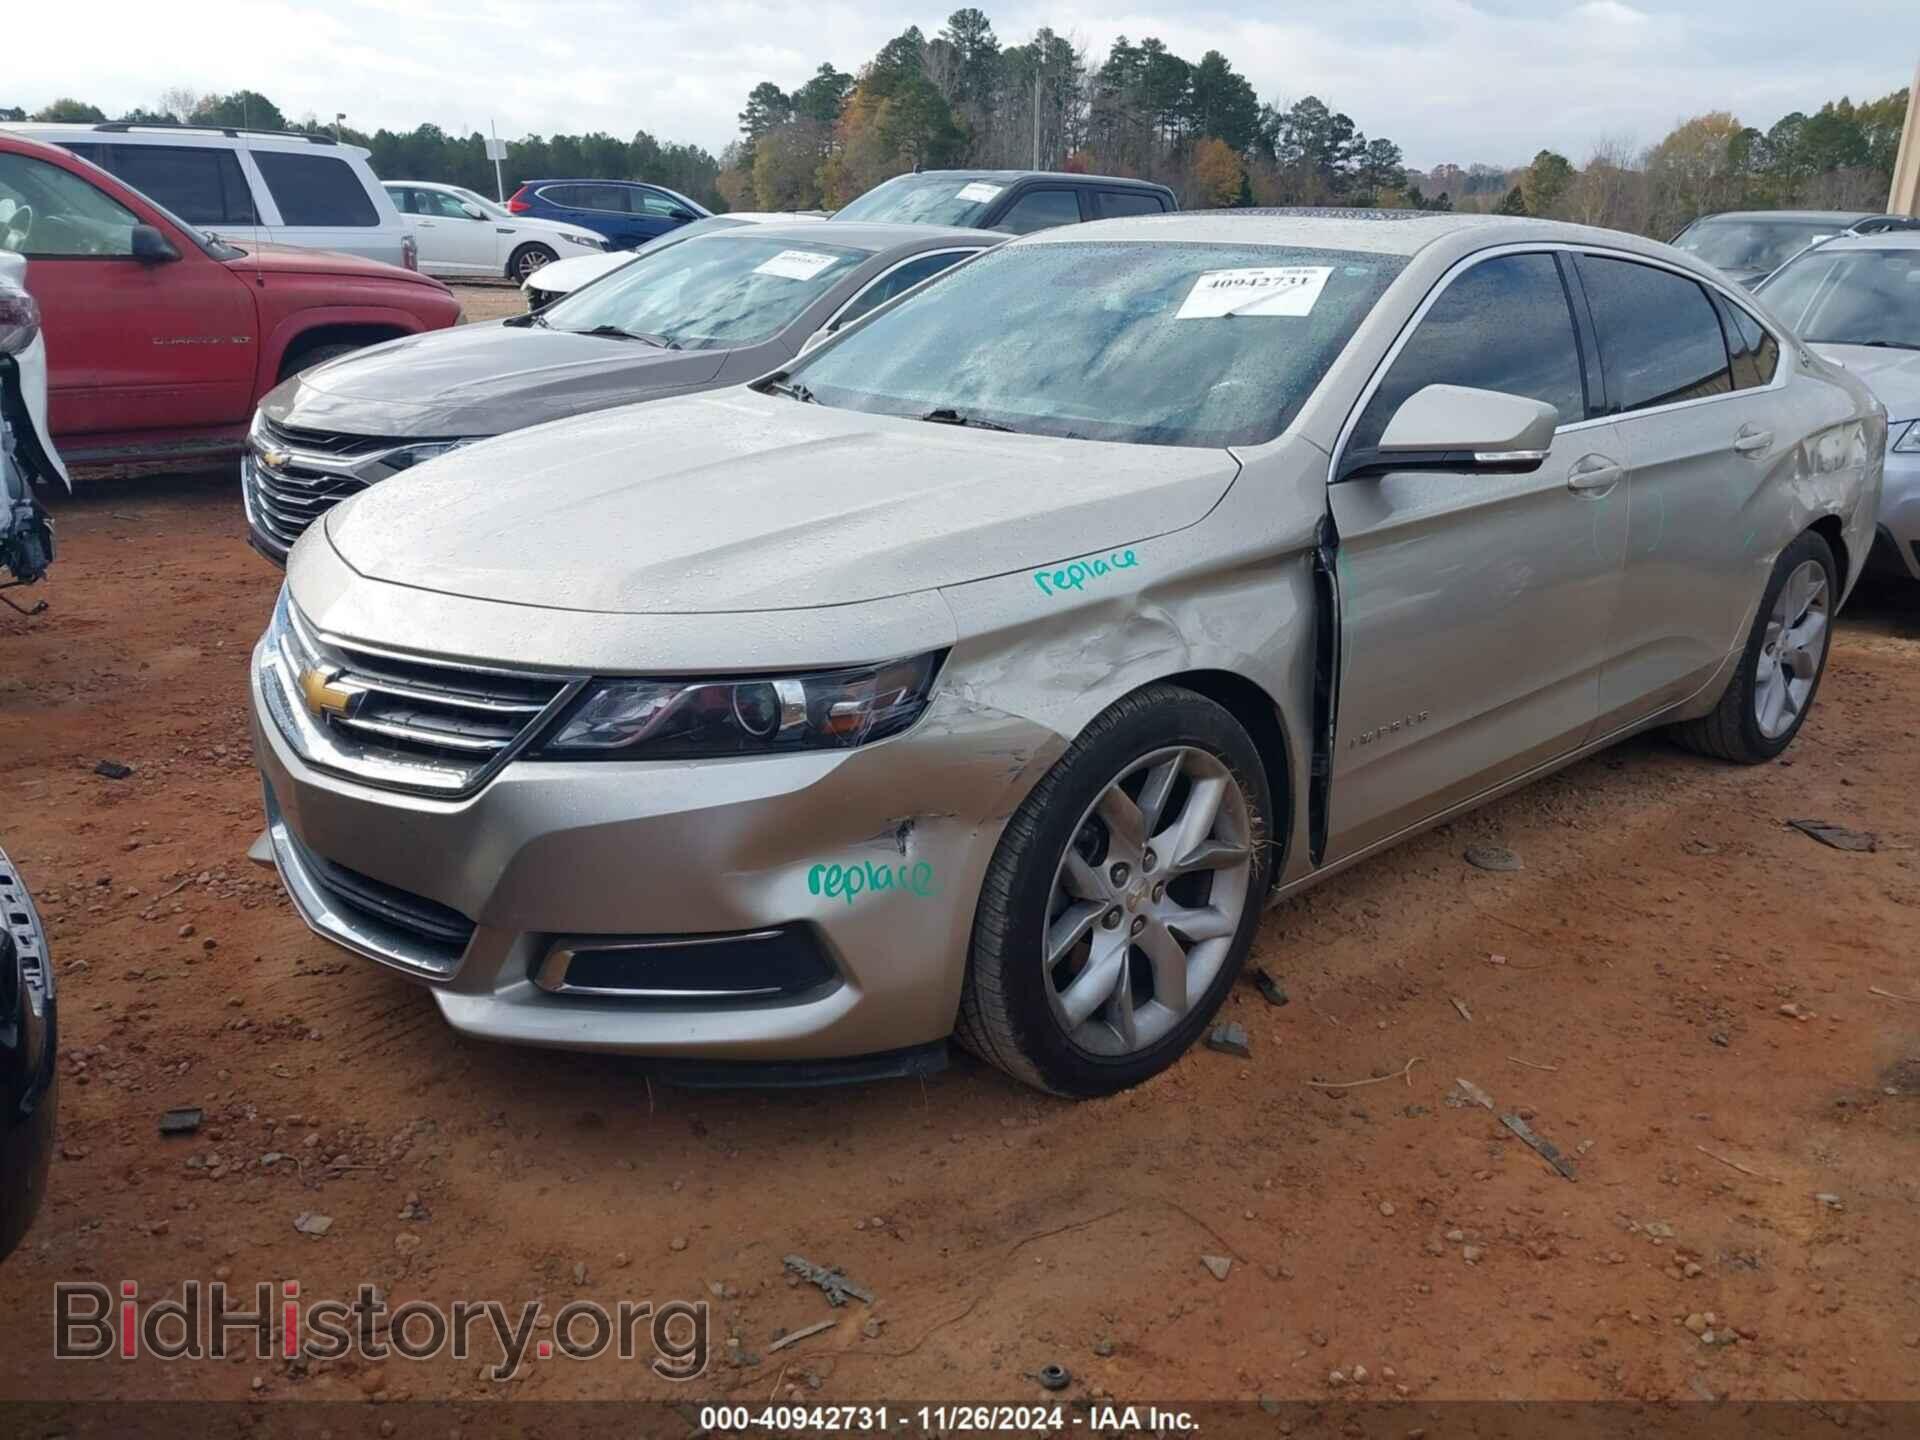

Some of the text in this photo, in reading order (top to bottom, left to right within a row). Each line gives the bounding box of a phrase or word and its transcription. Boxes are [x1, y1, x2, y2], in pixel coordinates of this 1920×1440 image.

[1208, 276, 1310, 289] 40942731
[152, 335, 224, 345] DURA
[1034, 550, 1139, 596] replace
[807, 860, 937, 904] replace
